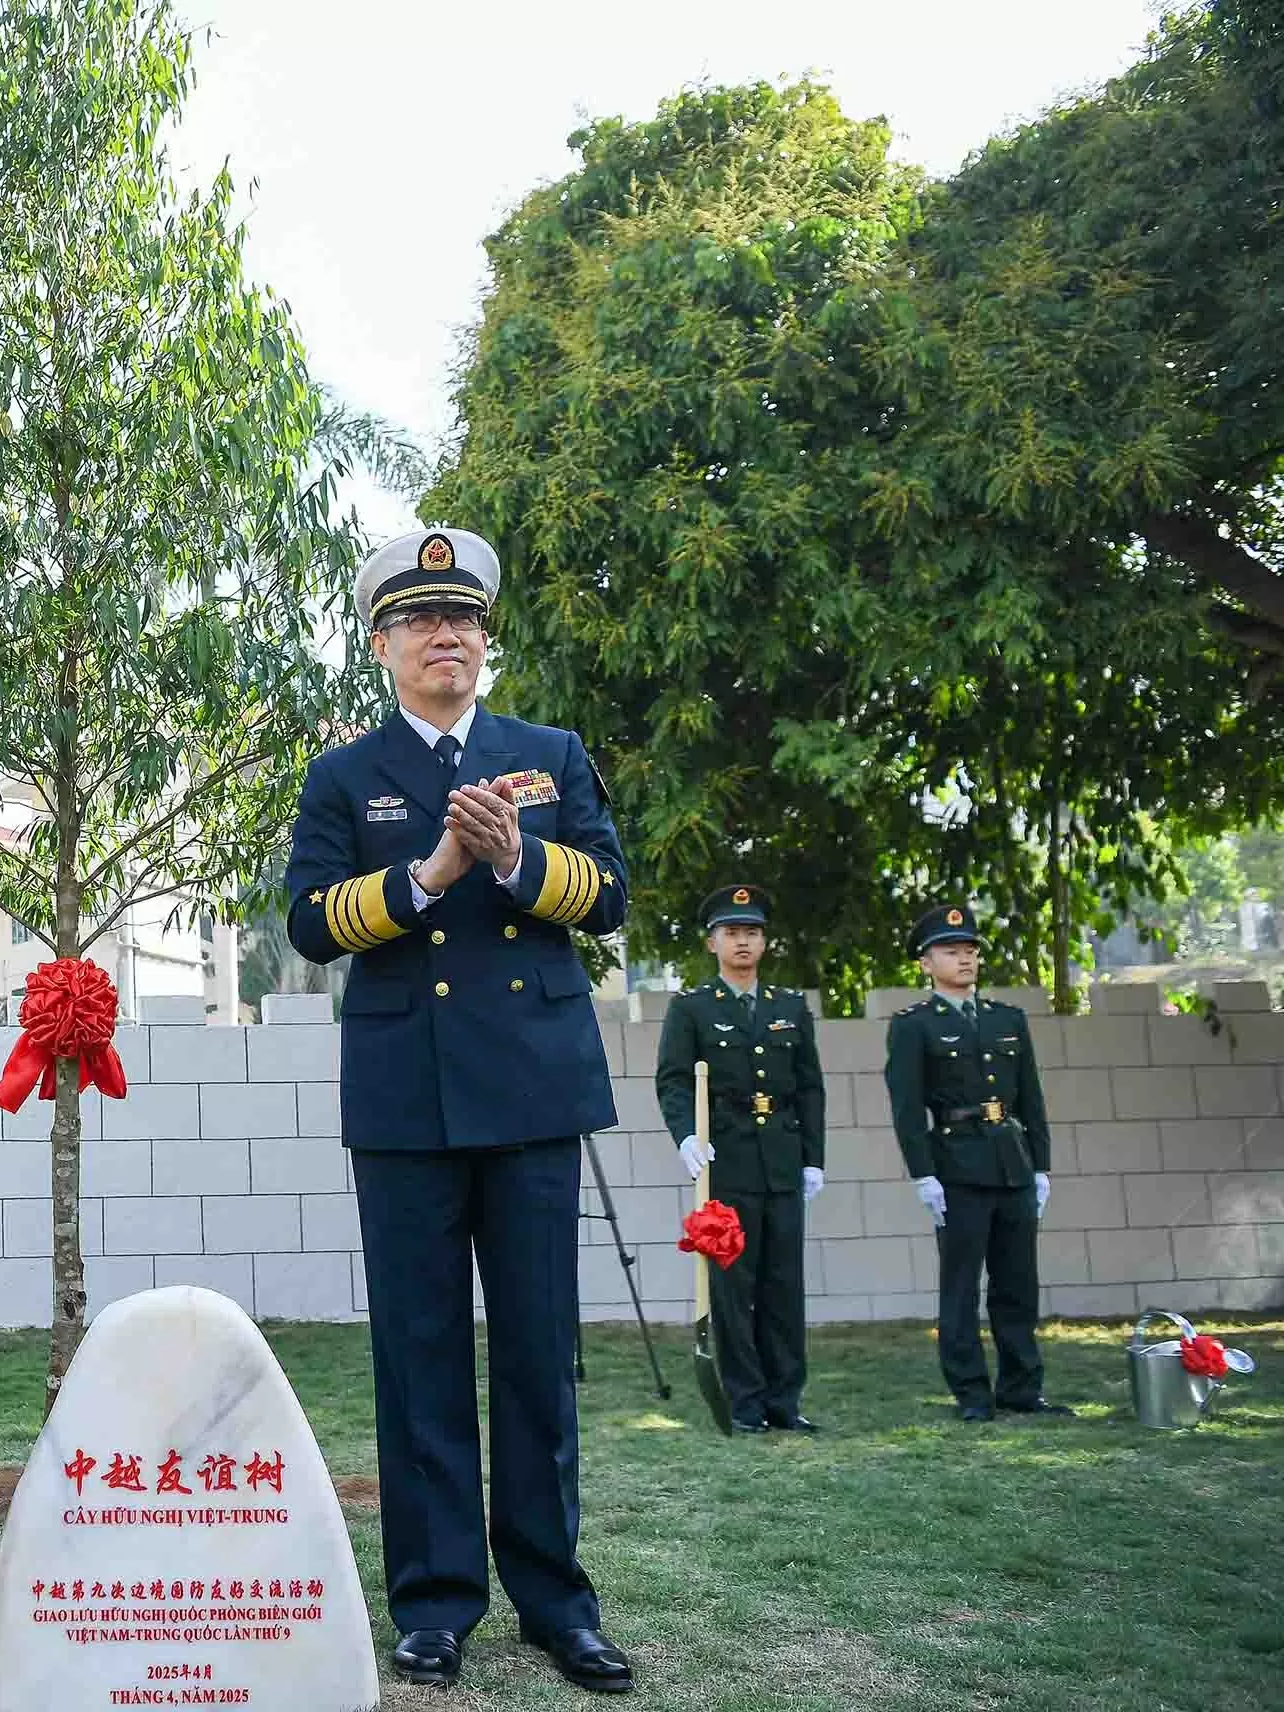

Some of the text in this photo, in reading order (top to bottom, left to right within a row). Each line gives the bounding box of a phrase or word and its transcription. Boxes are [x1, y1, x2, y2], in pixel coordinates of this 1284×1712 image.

[64, 1448, 286, 1496] 中越友谊树
[63, 1506, 289, 1527] CÂY HỮU NGHỊ VIỆT-TRUNG
[32, 1579, 323, 1602] 中越第九次边境国防友好交流活动
[33, 1603, 322, 1624] GIAO LƯU HỮU NGHỊ QUỐC PHÒNG BIÊN GIỚI
[67, 1628, 98, 1645] VIỆT
[100, 1628, 181, 1641] NAM-TRUNG
[183, 1624, 222, 1643] QUỐC
[253, 1624, 282, 1640] THỨ
[283, 1628, 291, 1640] 9
[147, 1664, 213, 1681] 2025年4月
[110, 1686, 250, 1706] THÁNG 4, NĂM 2025
